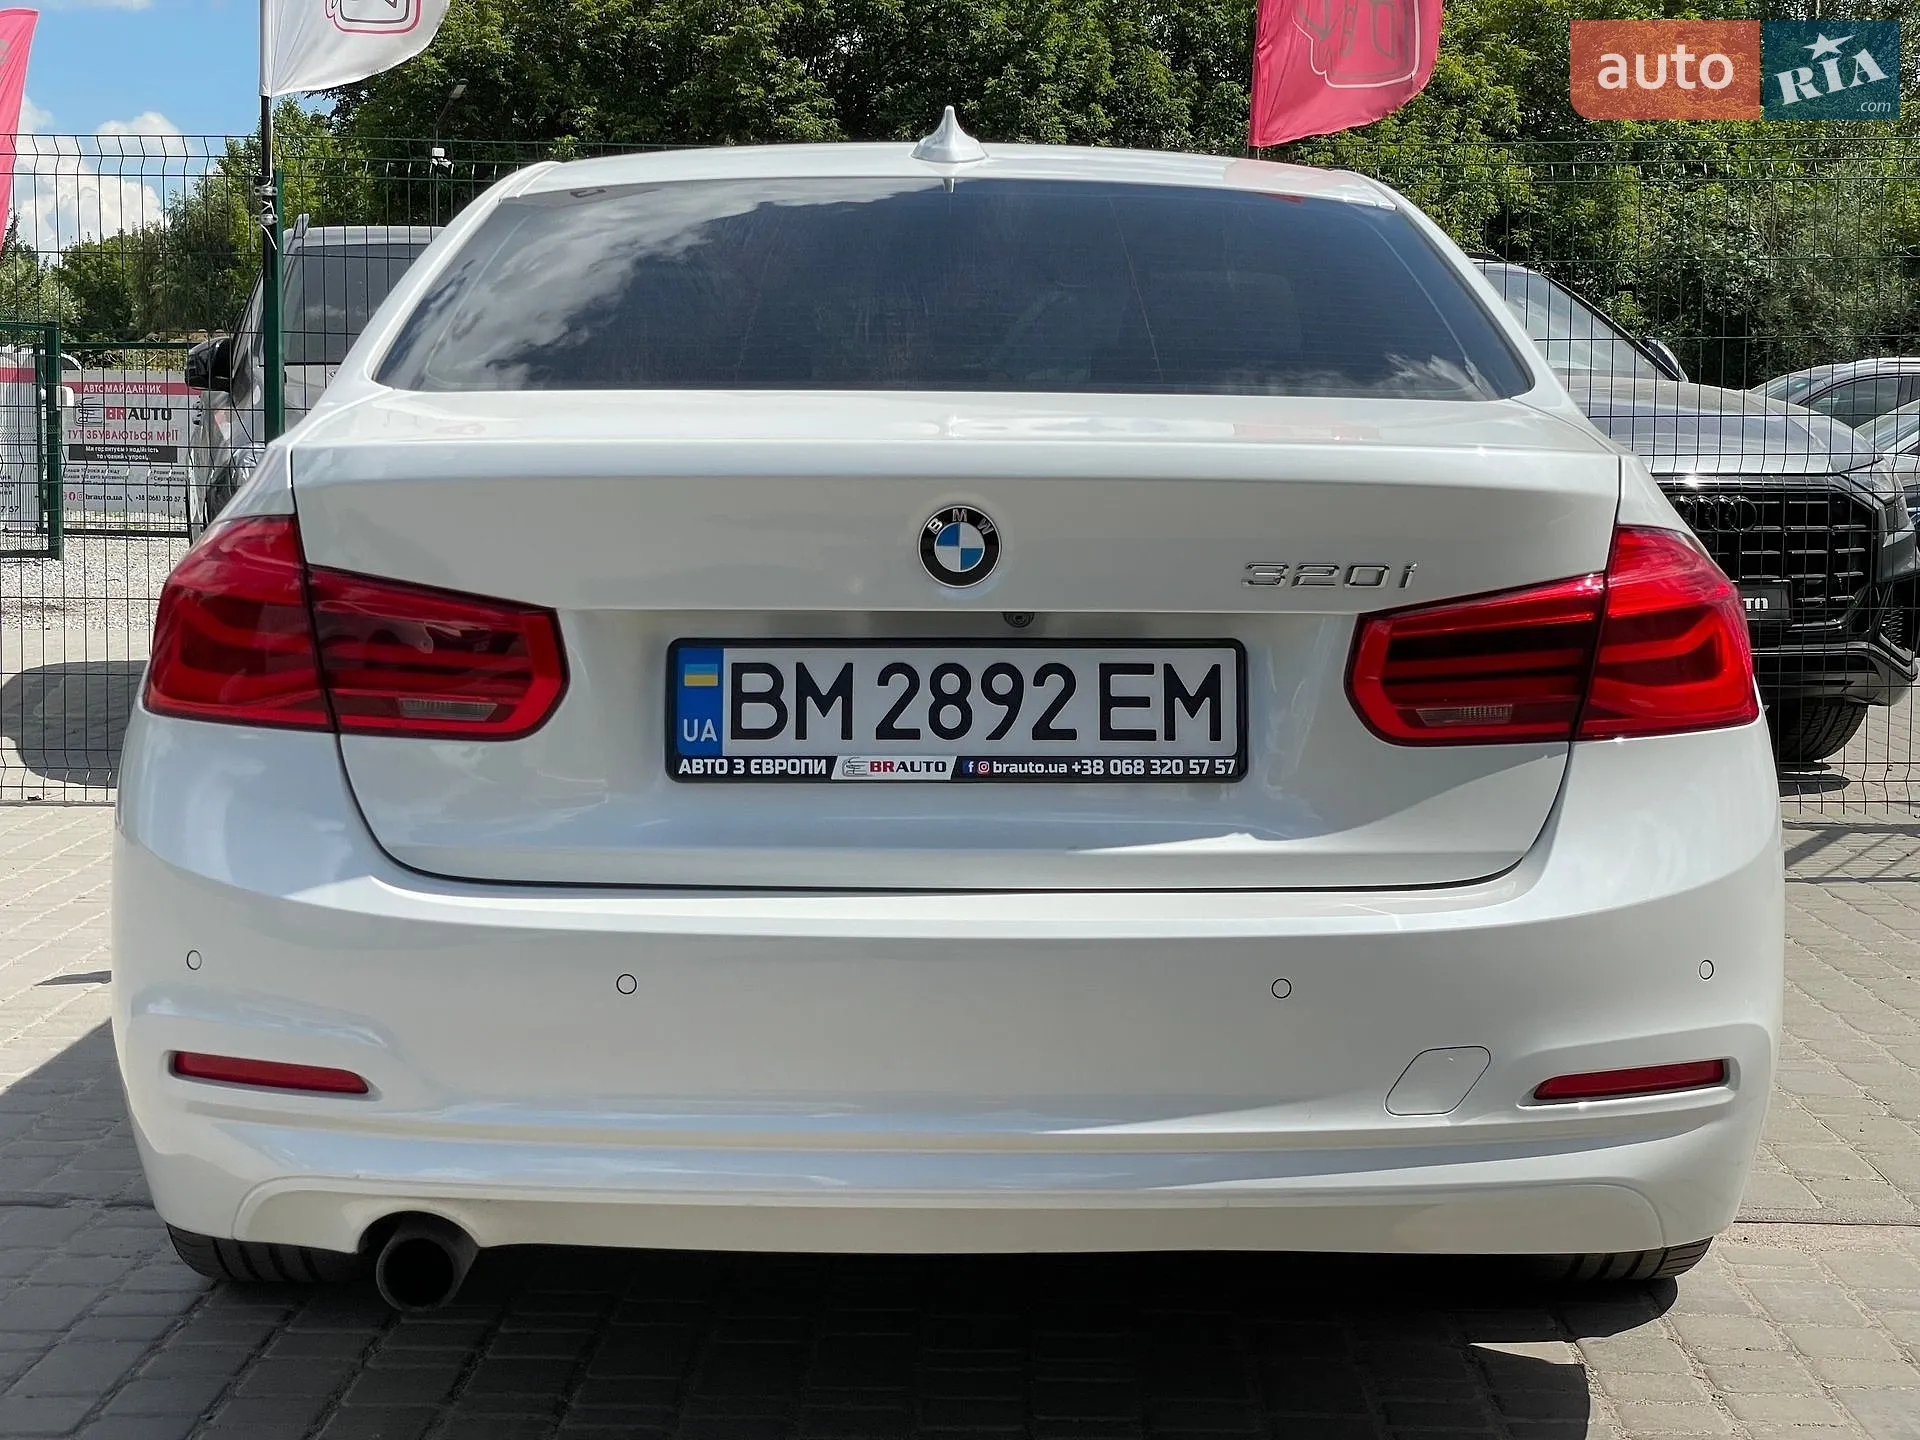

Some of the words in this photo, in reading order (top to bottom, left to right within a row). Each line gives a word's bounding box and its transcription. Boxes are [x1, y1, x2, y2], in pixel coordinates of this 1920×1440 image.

[105, 408, 172, 421] BRAUTO
[927, 508, 995, 535] BMW
[1241, 562, 1419, 589] 320i
[730, 662, 853, 742] BM
[875, 662, 1077, 742] 2892
[1099, 662, 1221, 742] EM
[683, 720, 717, 743] UA
[678, 758, 728, 775] АВТО
[750, 758, 826, 775] ЄВРОПИ
[869, 760, 947, 773] BRAUTO
[993, 761, 1068, 774] brauto.ua
[1071, 759, 1104, 775] +38
[1109, 759, 1145, 775] 068
[1150, 759, 1184, 775] 320
[1189, 760, 1209, 775] 57
[1215, 760, 1236, 775] 57
